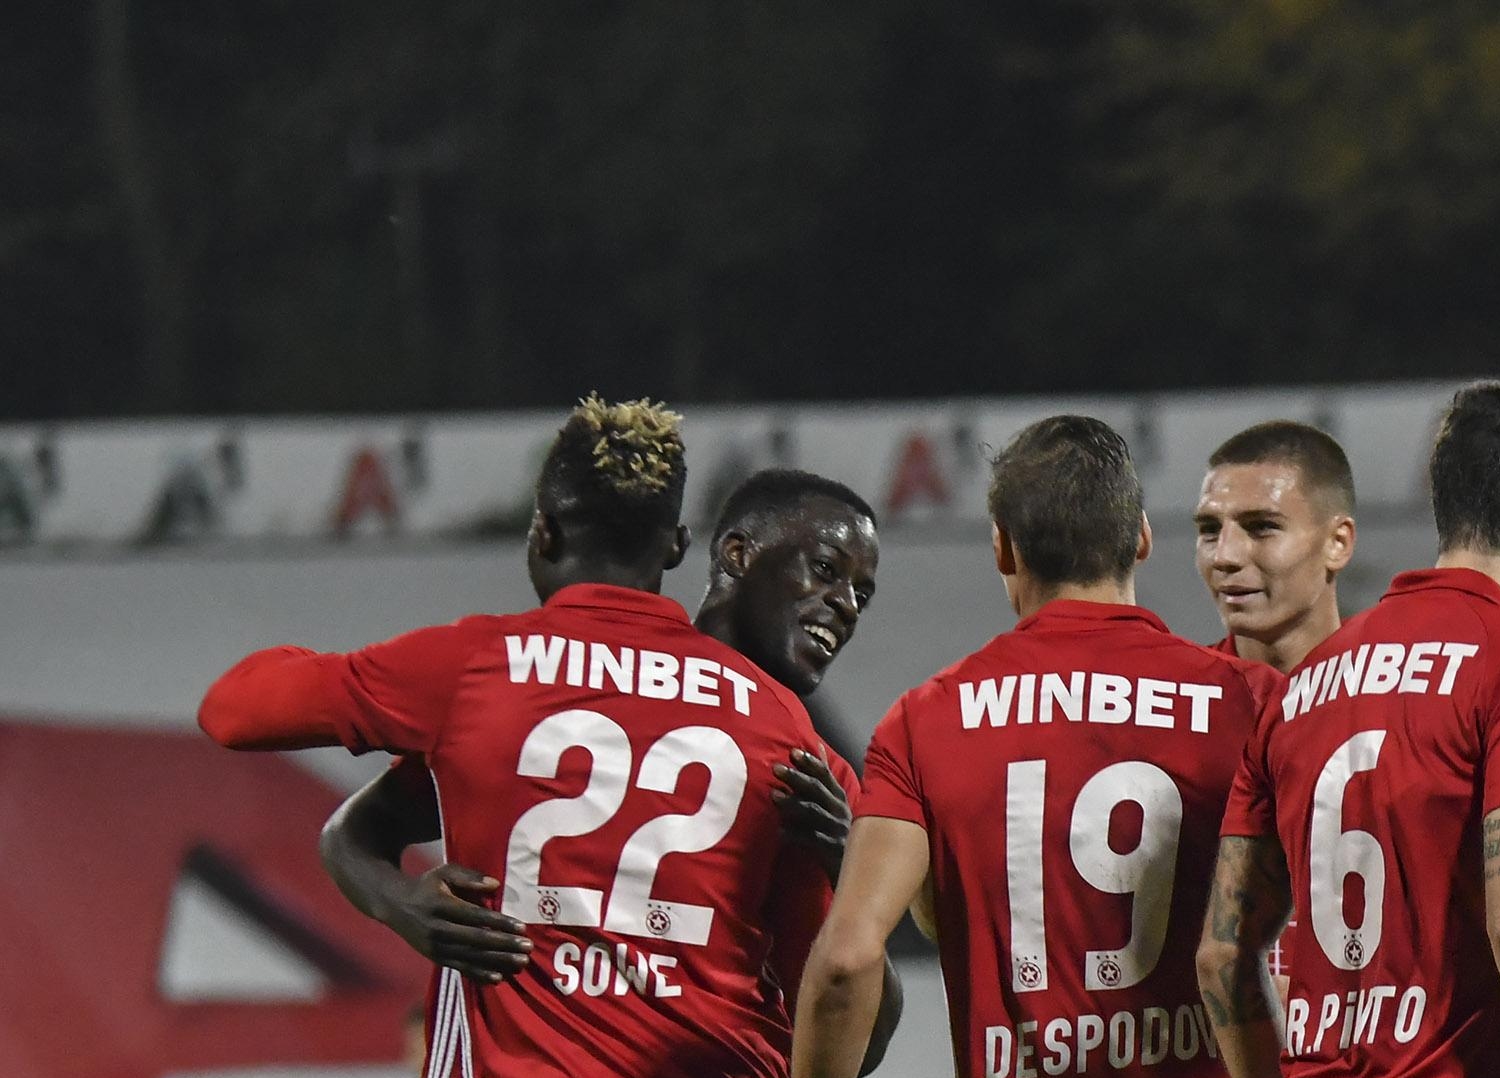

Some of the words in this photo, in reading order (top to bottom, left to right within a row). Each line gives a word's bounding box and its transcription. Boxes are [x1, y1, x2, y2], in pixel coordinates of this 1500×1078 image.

[505, 634, 758, 717] WINBET
[958, 671, 1223, 733] WINBET
[1282, 642, 1479, 722] WINBET
[501, 709, 748, 946] 22
[1310, 729, 1387, 970] 6
[1006, 759, 1183, 993] 19
[553, 942, 682, 997] SOWE
